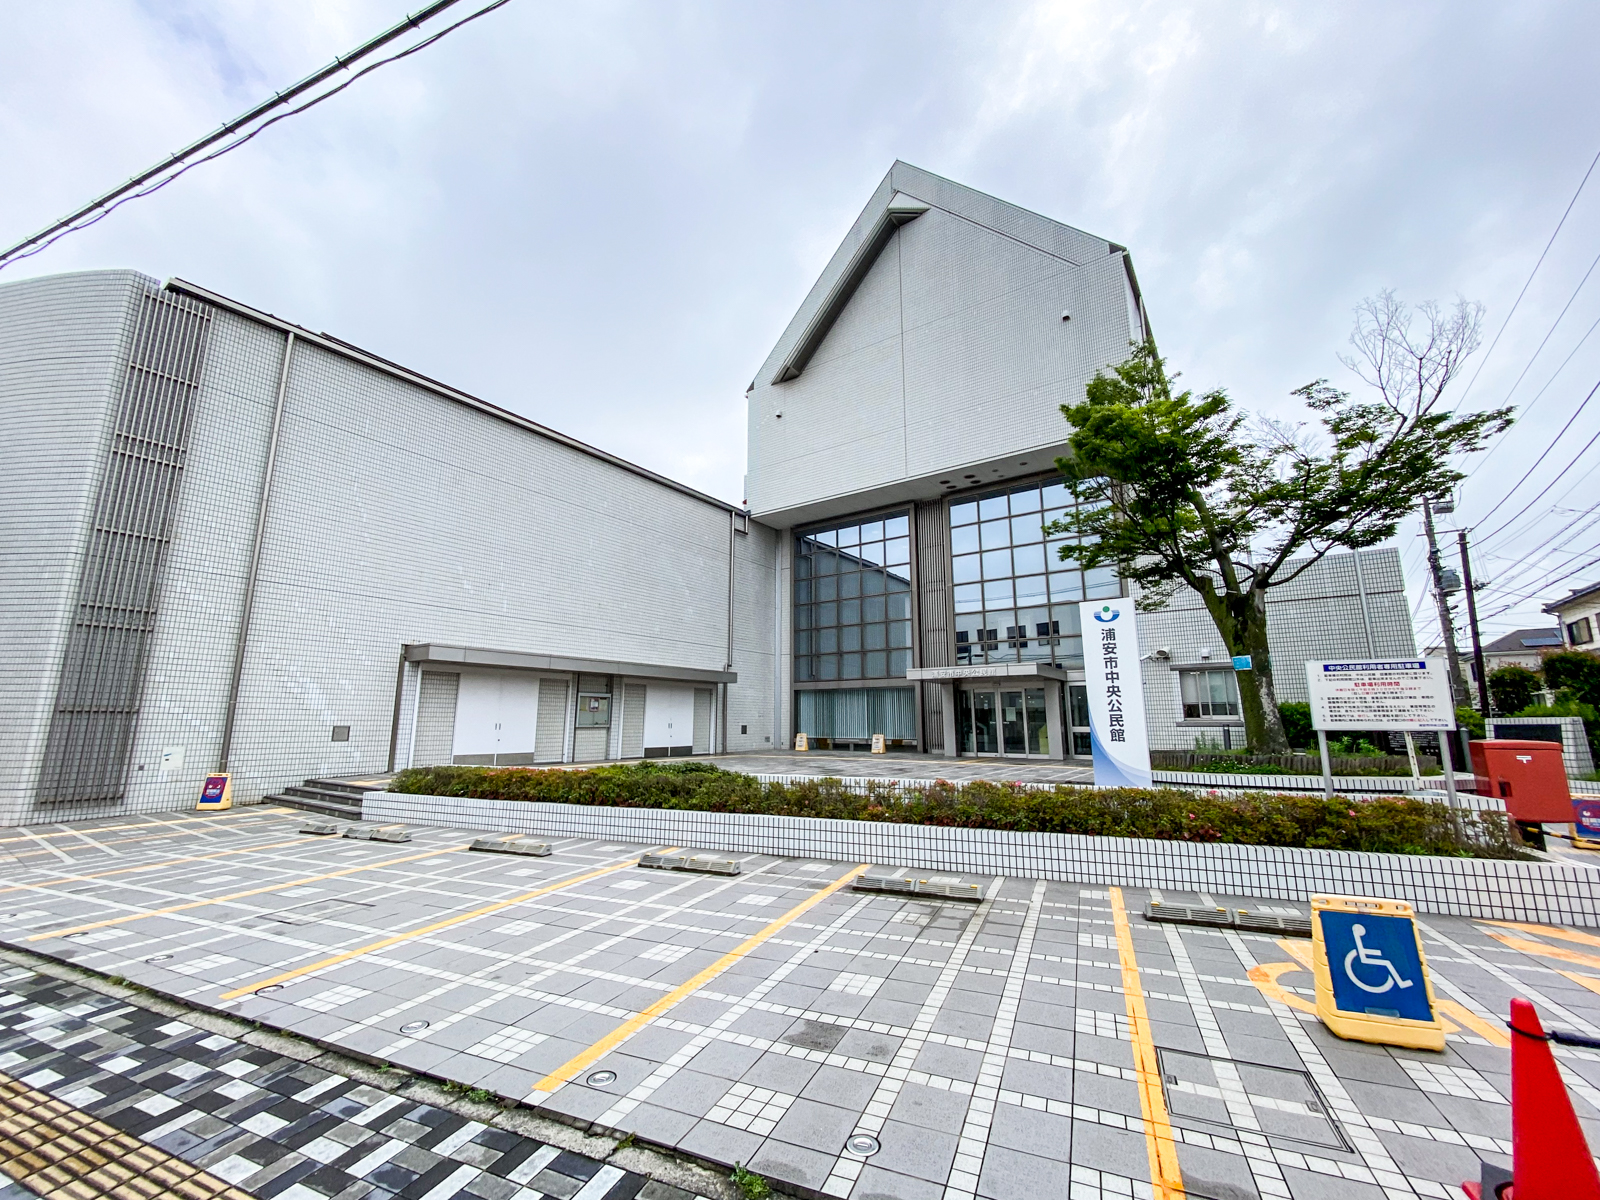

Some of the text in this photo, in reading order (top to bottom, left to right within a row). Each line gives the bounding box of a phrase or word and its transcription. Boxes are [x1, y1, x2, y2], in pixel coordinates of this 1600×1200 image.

[1101, 628, 1126, 743] 浦安市中央公民館
[1328, 662, 1420, 671] 中央公民館利用者専用駐車場
